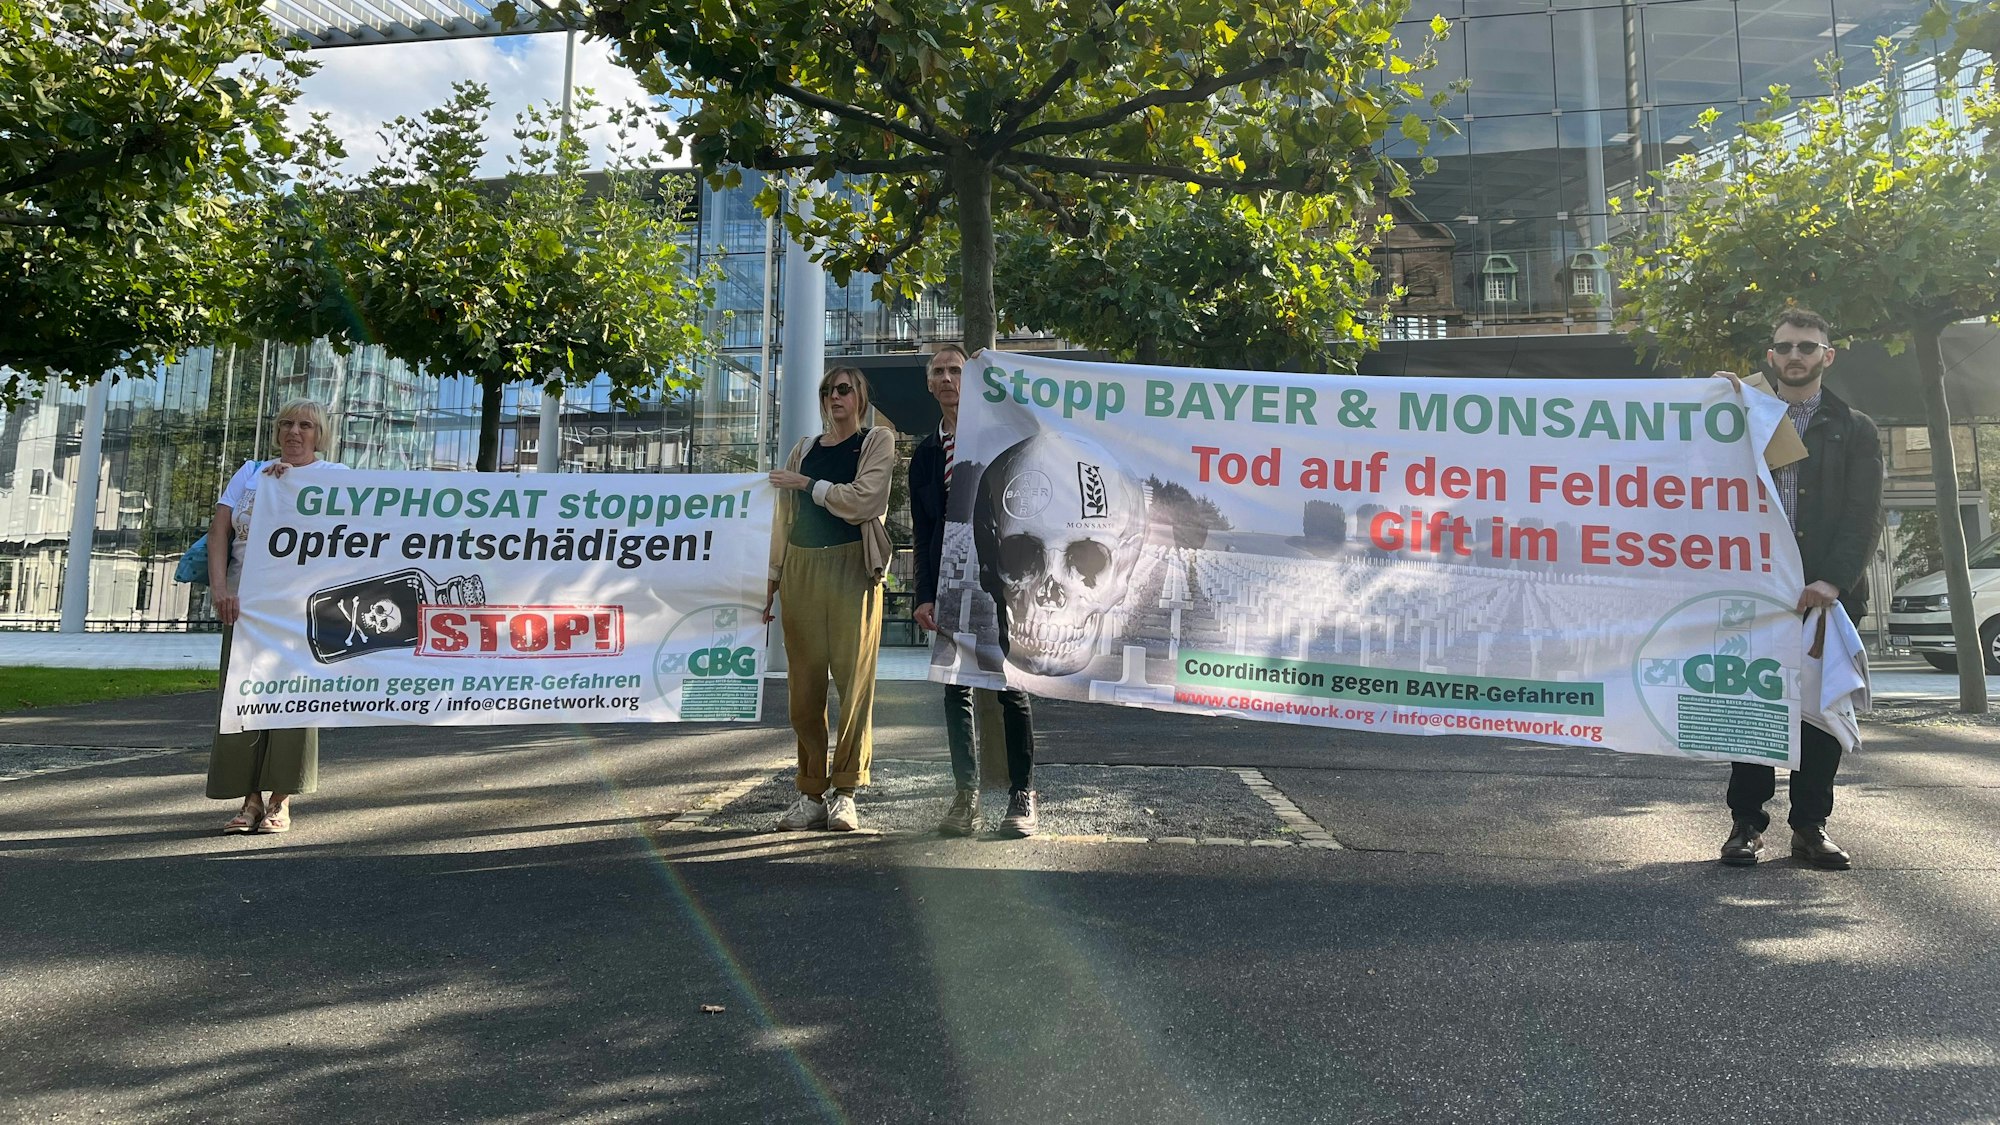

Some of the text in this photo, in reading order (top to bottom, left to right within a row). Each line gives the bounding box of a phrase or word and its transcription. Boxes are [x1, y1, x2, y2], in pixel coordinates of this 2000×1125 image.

[982, 366, 1750, 443] Stopp BAYER & MONSANTO
[1191, 446, 1768, 513] Tod auf den Feldern!
[296, 486, 548, 519] GLYPHOSAT
[558, 489, 751, 527] stoppen!
[268, 524, 713, 569] Opfer entschädigen!
[1370, 511, 1772, 572] Gift im Essen!
[430, 613, 610, 652] STOP!
[688, 646, 756, 677] CBG
[1185, 659, 1595, 706] Coordination gegen BAYER-Gefahren
[1683, 654, 1783, 700] CBG
[236, 695, 640, 716] www.CBGnetwork.org / info@CBGnetwork.org
[239, 673, 641, 696] Coordination gegen BAYER-Gefahren
[1174, 690, 1604, 742] www.CBGnetwork.org / info@CBGnetwork.org
